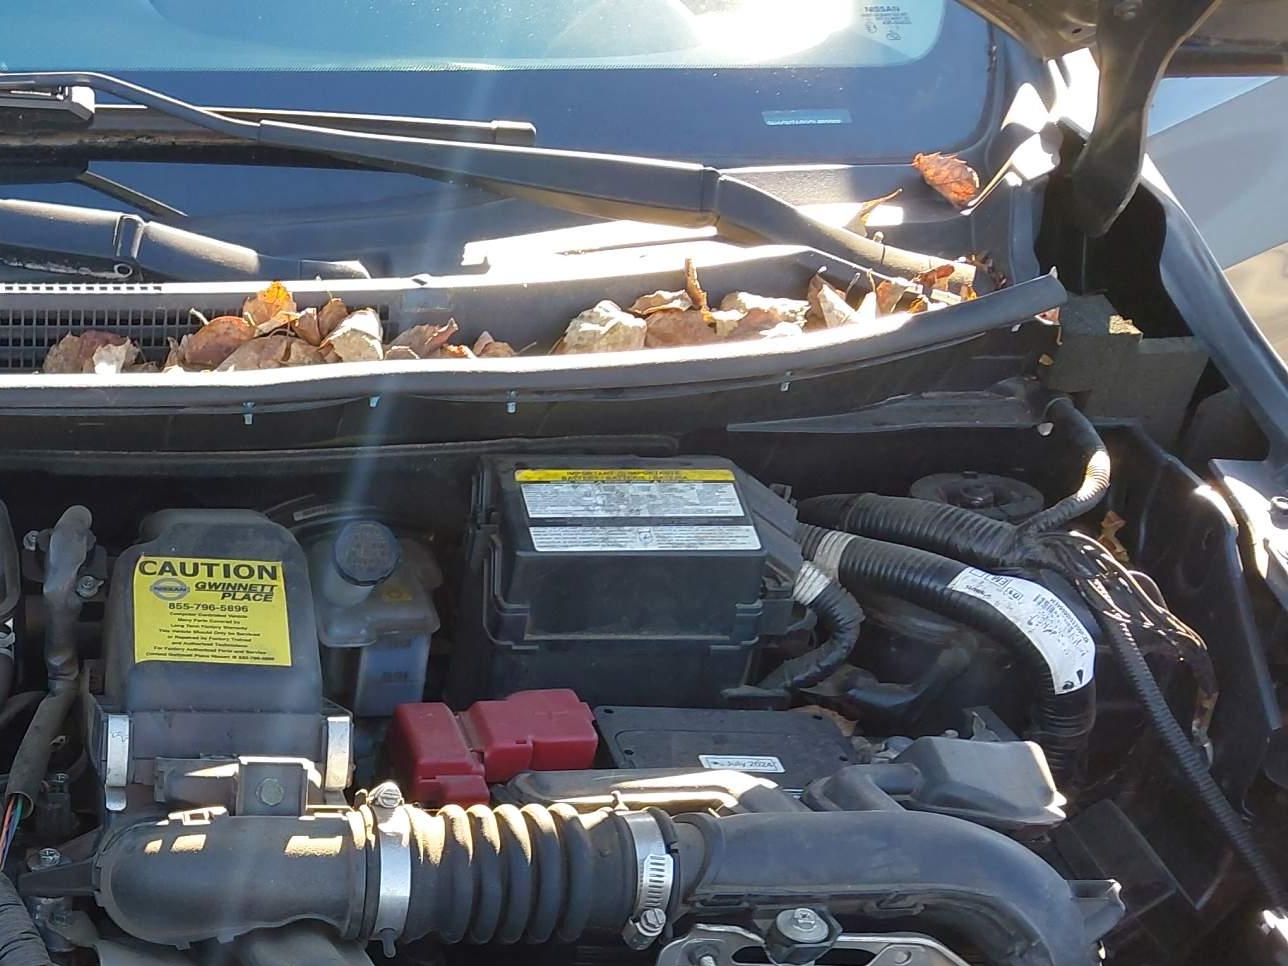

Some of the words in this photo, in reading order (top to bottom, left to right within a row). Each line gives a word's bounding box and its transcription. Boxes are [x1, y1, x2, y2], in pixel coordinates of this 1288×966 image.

[138, 560, 278, 580] CAUTION
[195, 582, 278, 594] GWINNETT
[220, 592, 274, 602] PLACE
[168, 602, 249, 612] 855-796-5896
